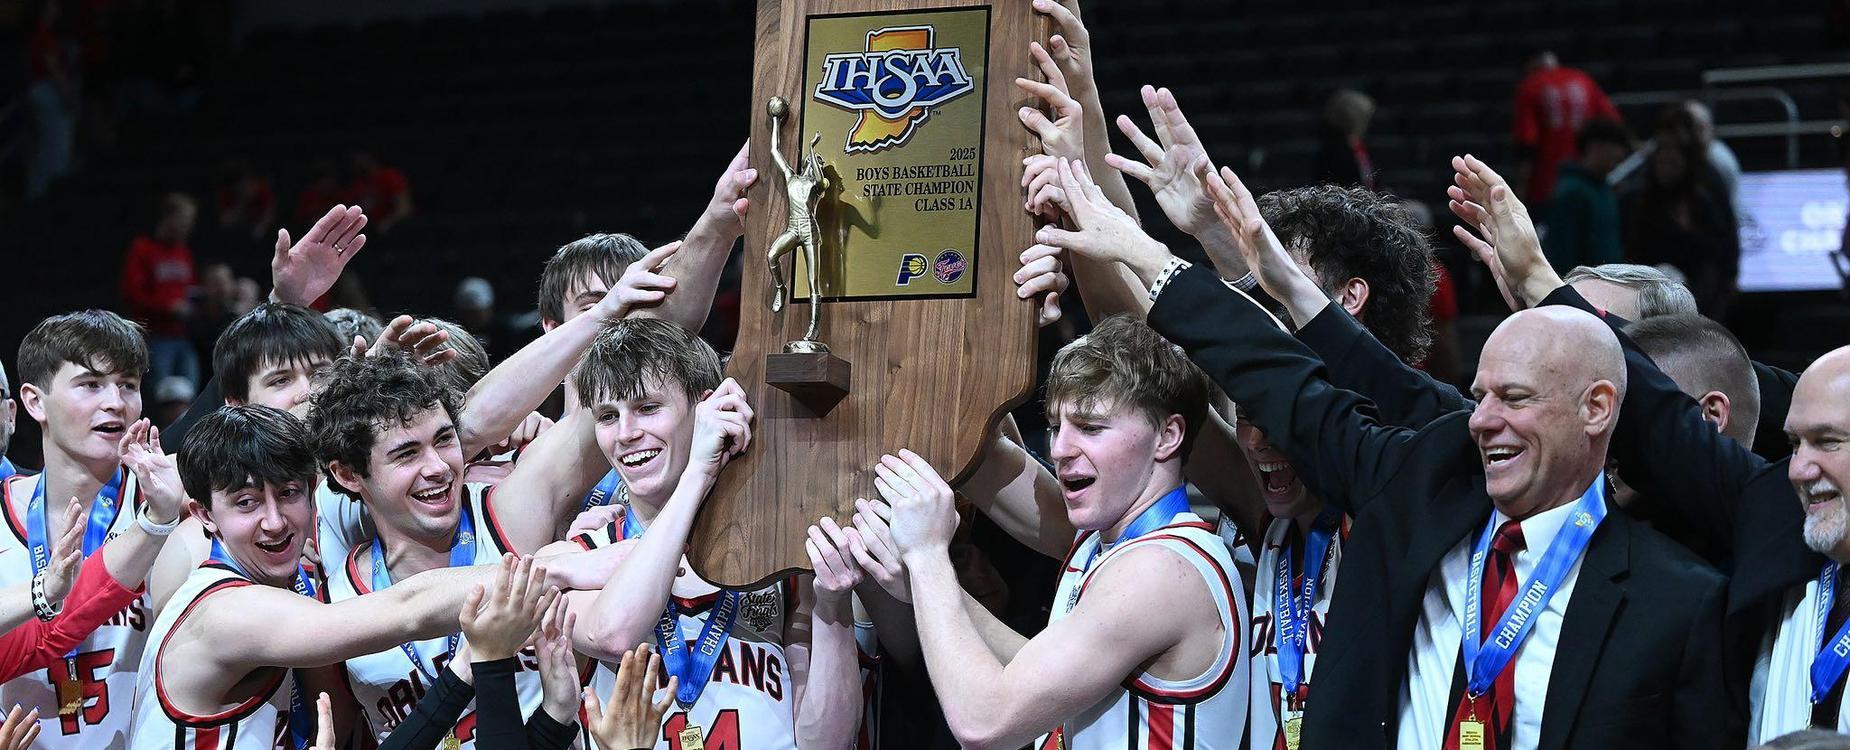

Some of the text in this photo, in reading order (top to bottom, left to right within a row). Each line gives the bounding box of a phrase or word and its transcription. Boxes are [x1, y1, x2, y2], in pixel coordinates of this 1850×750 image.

[819, 53, 969, 107] IHSAA
[856, 163, 975, 181] BOYS BASKETBALL
[949, 147, 976, 160] 2025
[863, 180, 974, 197] STATE CHAMPION
[914, 197, 973, 212] CLASS 1A
[700, 589, 735, 657] CHAMPION
[1279, 558, 1294, 645] BASKETBALL
[1295, 577, 1314, 647] CHAMPION
[1465, 550, 1484, 641] BASKETBALL
[1495, 579, 1548, 650] CHAMPION
[47, 647, 116, 736] 15
